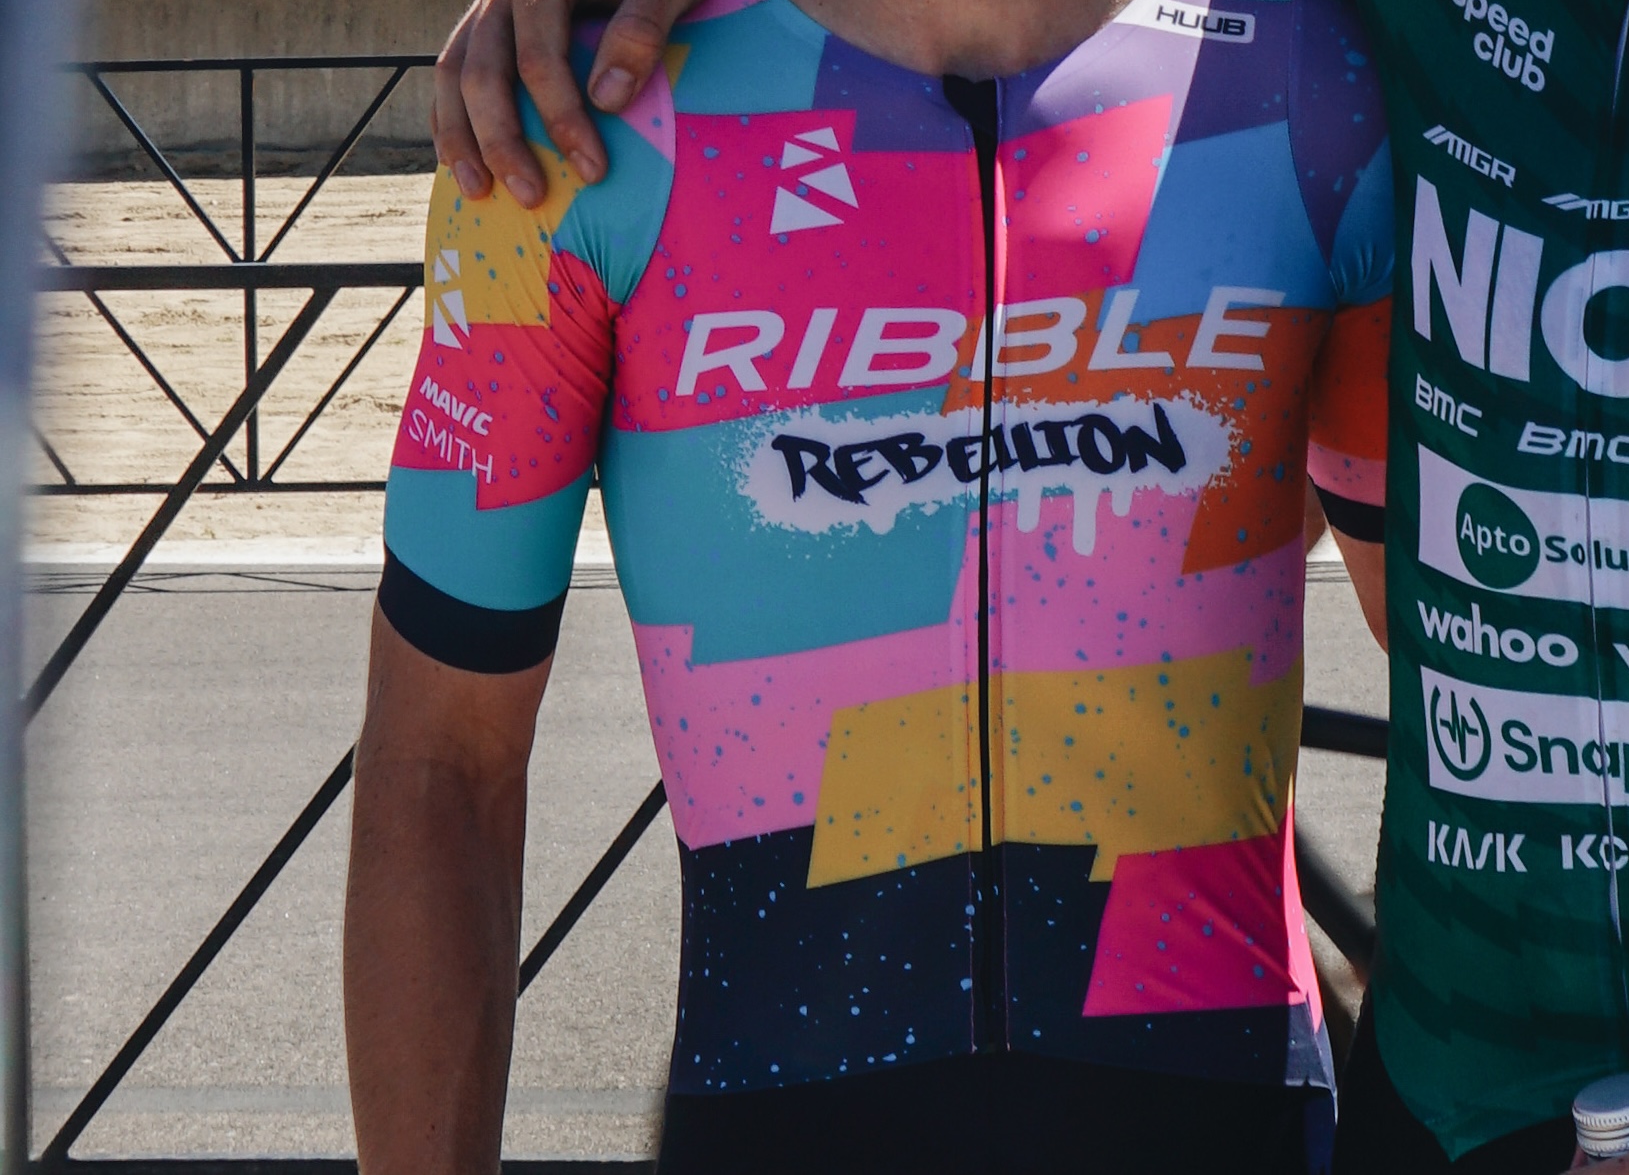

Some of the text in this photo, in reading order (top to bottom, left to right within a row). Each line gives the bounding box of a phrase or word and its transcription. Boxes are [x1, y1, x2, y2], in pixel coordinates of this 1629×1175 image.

[1156, 5, 1247, 37] HUUB
[1473, 32, 1546, 92] club
[675, 287, 1286, 396] RIBBLE
[419, 376, 493, 436] MAVIC
[1415, 373, 1482, 437] BMC
[408, 409, 494, 485] SMITH
[771, 403, 1187, 506] REBELLION
[1460, 512, 1532, 556] Apto
[1416, 599, 1579, 667] wahoo
[1428, 819, 1527, 873] KASK
